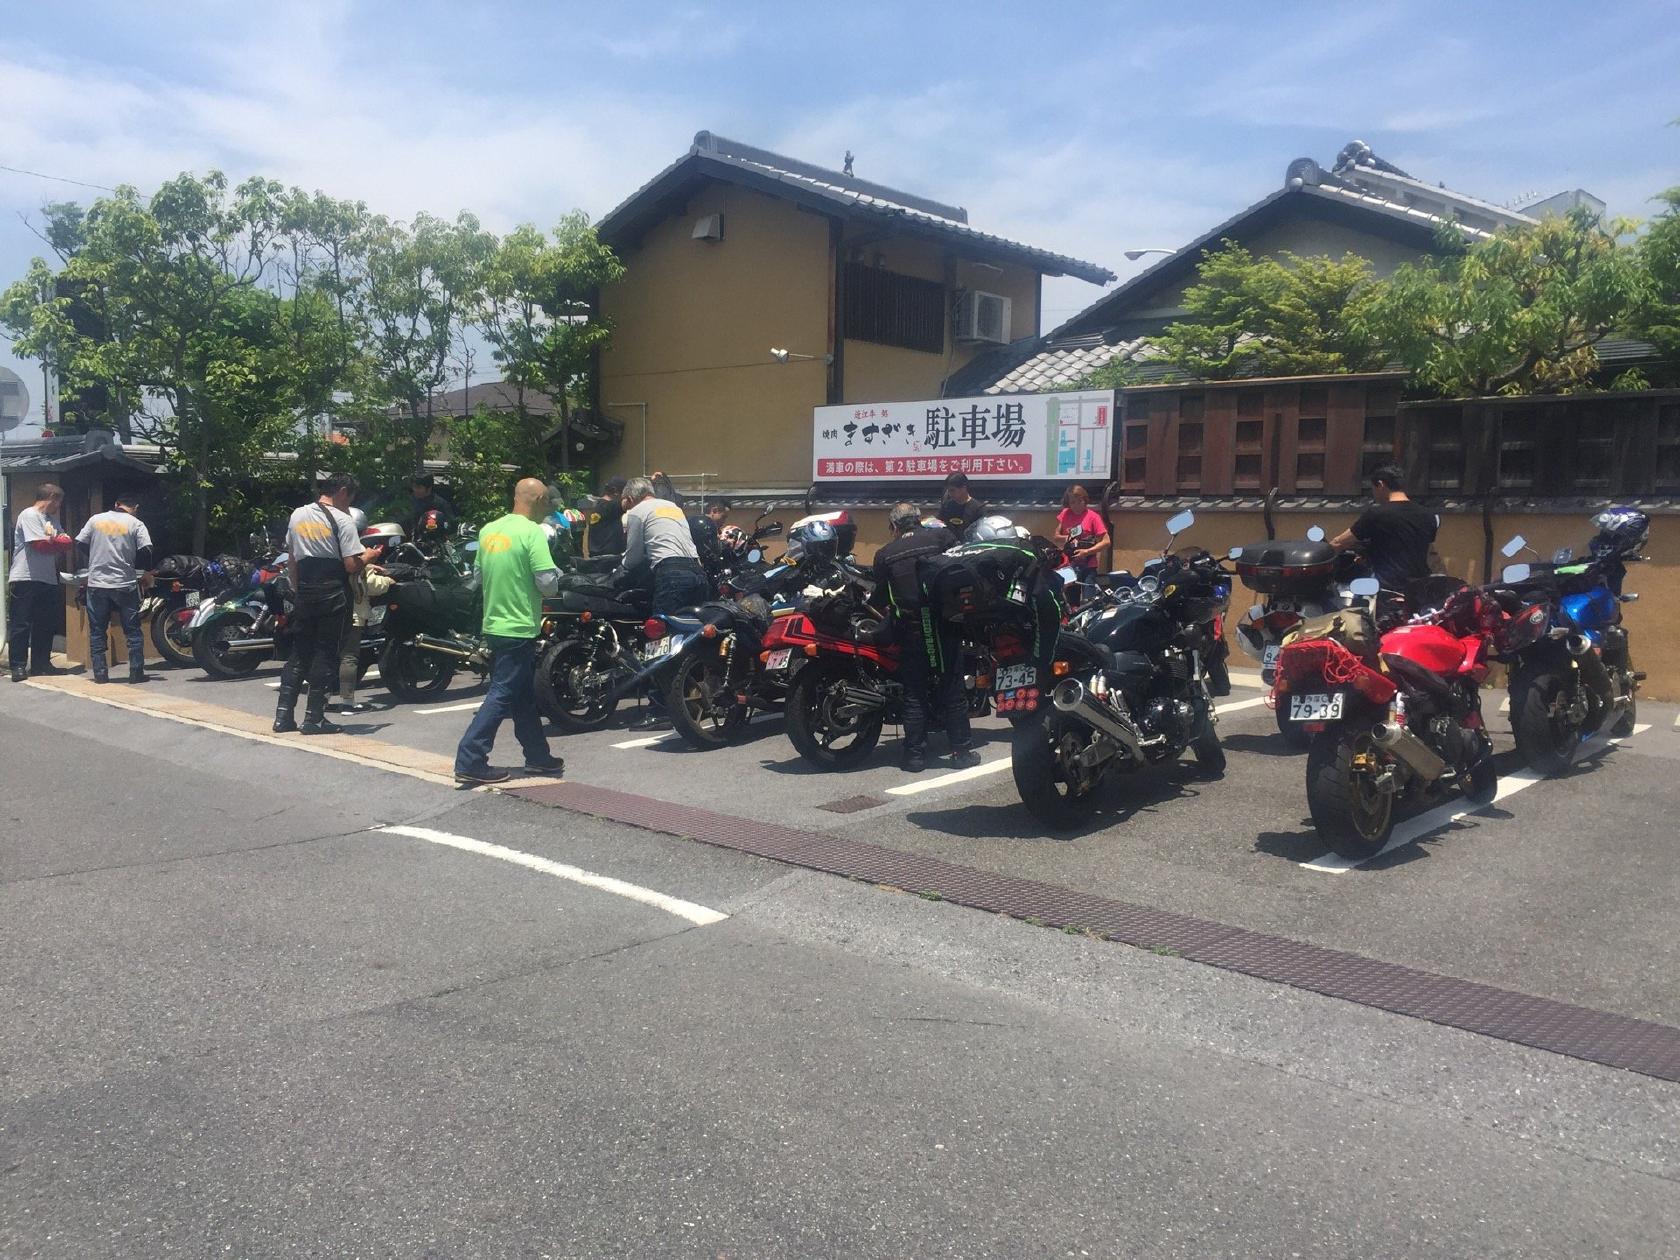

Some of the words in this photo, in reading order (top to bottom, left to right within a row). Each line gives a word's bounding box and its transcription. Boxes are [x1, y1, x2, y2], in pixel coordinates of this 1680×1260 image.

[822, 429, 838, 440] 焼肉
[924, 402, 1027, 450] 駐車場
[998, 671, 1034, 689] 73-45
[1293, 703, 1340, 719] 79-39
